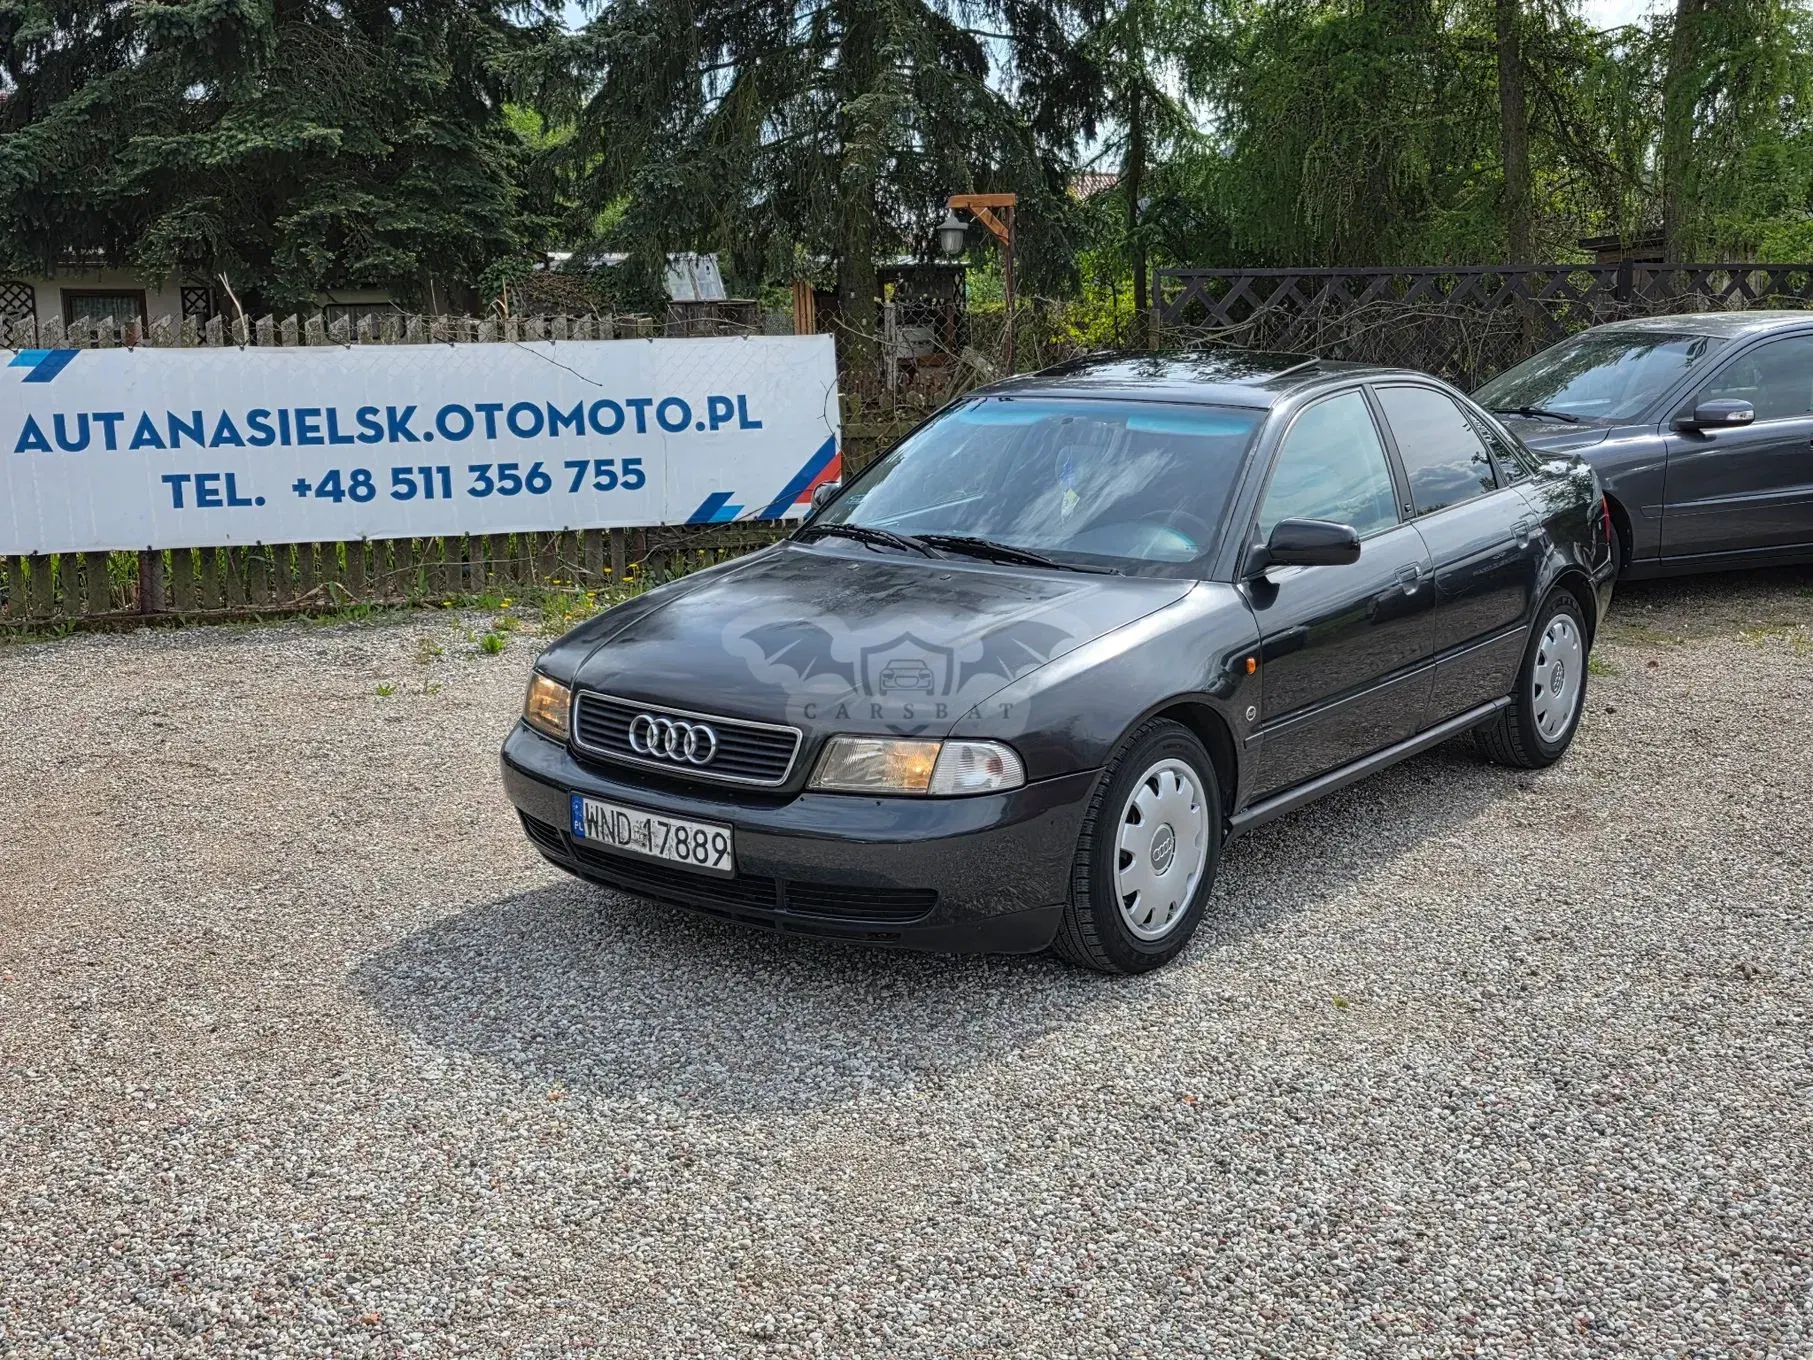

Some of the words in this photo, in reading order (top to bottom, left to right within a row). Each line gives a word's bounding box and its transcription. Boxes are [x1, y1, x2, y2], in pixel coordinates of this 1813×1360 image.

[13, 394, 763, 454] AUTANASIELSK.OTOMOTO.PL
[161, 473, 266, 509] TEL.
[291, 468, 377, 505] +48
[390, 465, 452, 501] 511
[467, 461, 553, 498] 356
[563, 457, 647, 493] 755
[574, 820, 584, 832] PL
[584, 802, 633, 846] WND
[643, 818, 729, 867] 17889
